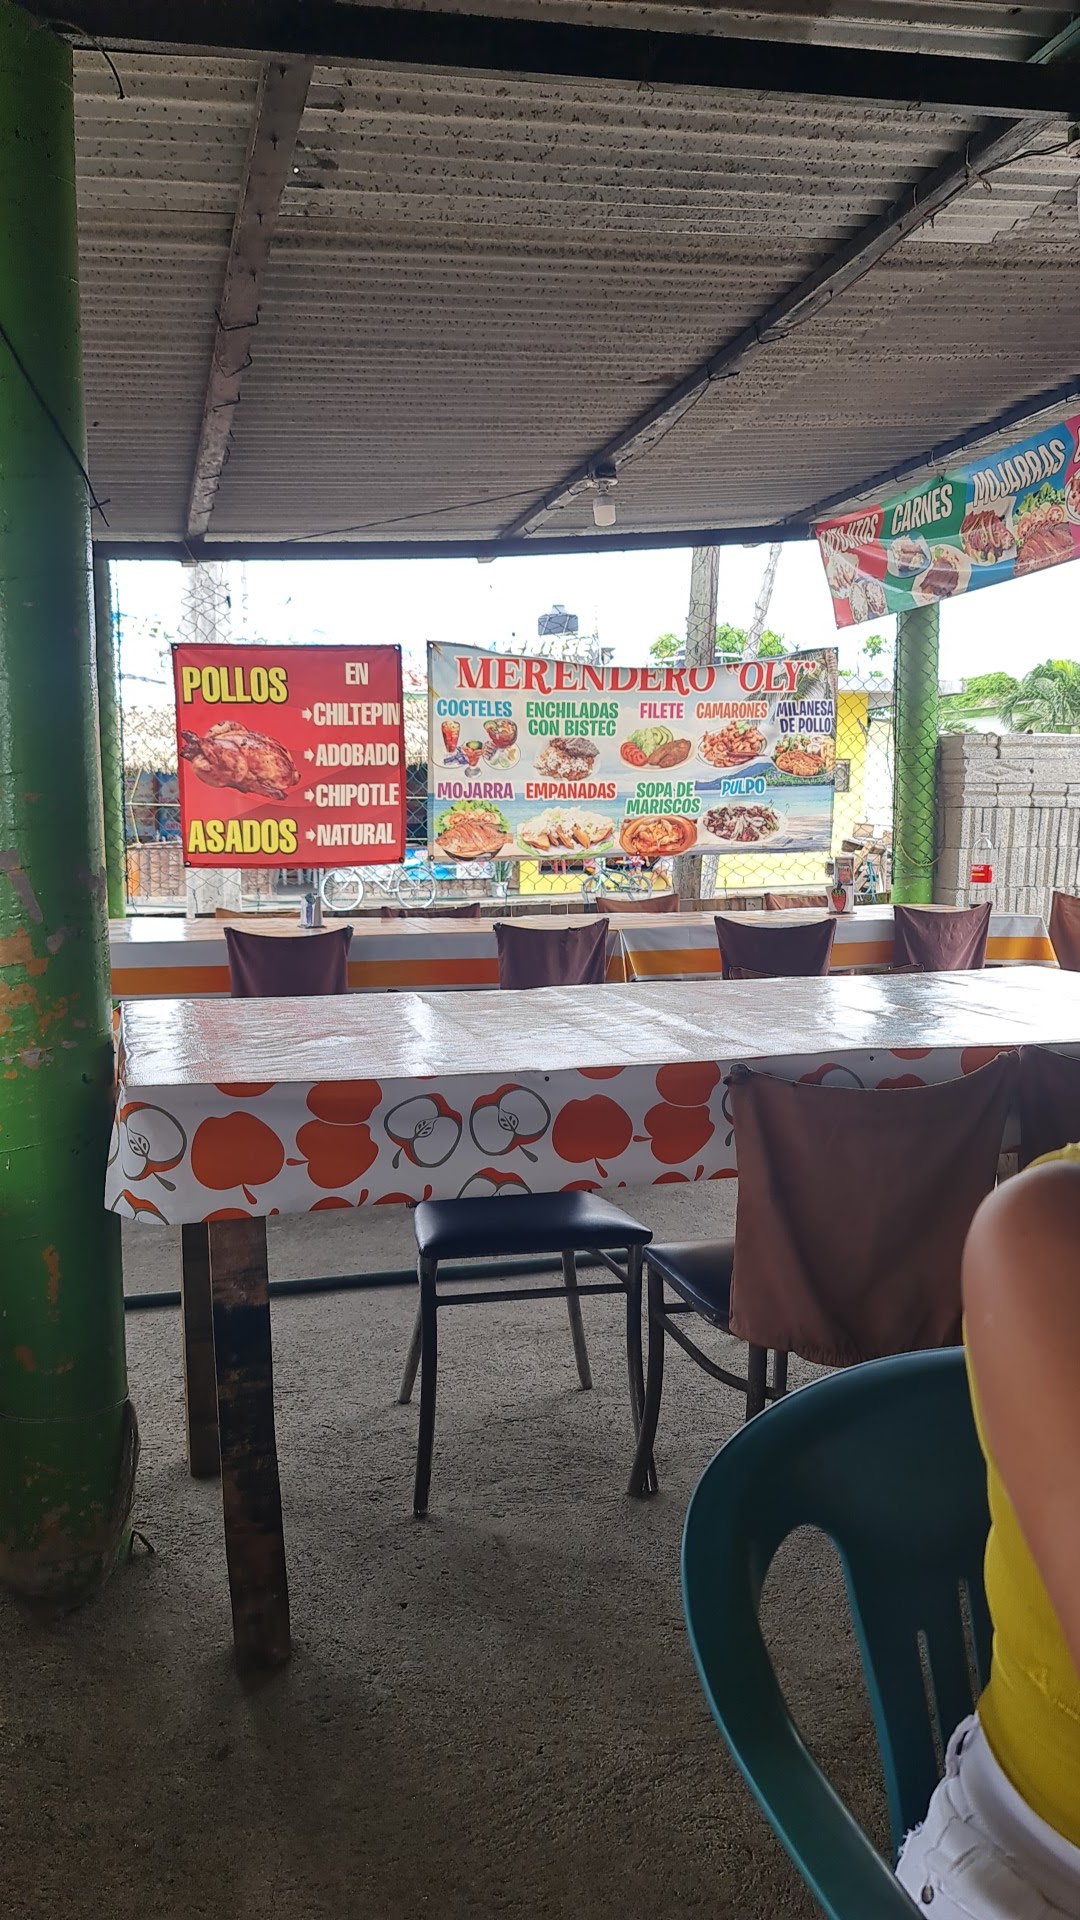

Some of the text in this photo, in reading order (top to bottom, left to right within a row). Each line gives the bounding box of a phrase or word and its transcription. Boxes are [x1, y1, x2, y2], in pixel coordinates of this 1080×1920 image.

[972, 438, 1066, 506] MOJARRAS
[890, 483, 953, 535] CARNES
[345, 662, 368, 685] EN
[456, 658, 716, 696] MERENDERO
[181, 666, 288, 703] POLLOS
[313, 703, 400, 726] CHILTEPIN
[437, 700, 512, 717] COCTELES
[526, 702, 618, 718] ENCHILADAS
[640, 703, 683, 718] FILETE
[696, 702, 768, 718] CAMARONES
[776, 700, 834, 717] MILANESA
[528, 720, 616, 736] CON BISTEC
[780, 718, 831, 733] DE POLLO
[315, 743, 399, 767] ADOBADO
[315, 783, 399, 806] CHIPOTLE
[437, 782, 514, 799] MOJARRA
[525, 782, 616, 799] EMPANADAS
[636, 782, 693, 798] SOPA DE
[721, 778, 765, 795] PULPO
[626, 798, 700, 815] MARISCOS
[188, 819, 298, 855] ASADOS
[316, 823, 395, 846] NATURAL
